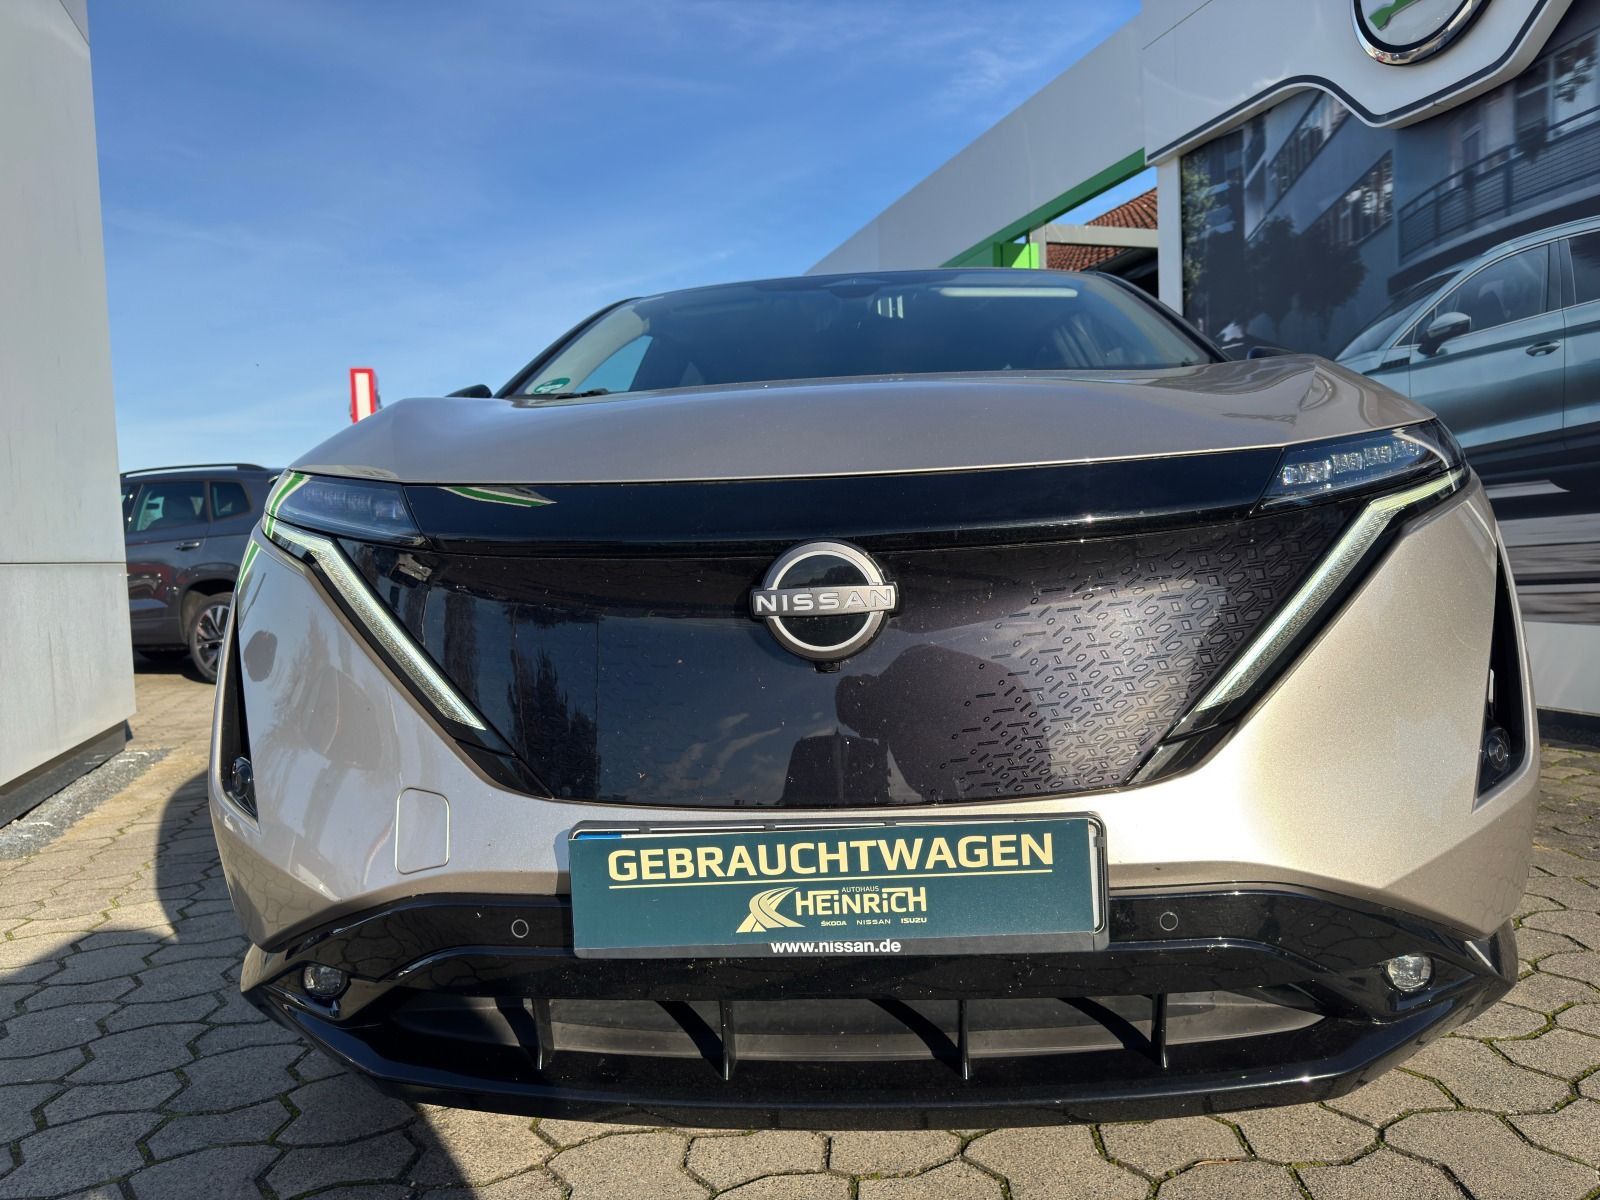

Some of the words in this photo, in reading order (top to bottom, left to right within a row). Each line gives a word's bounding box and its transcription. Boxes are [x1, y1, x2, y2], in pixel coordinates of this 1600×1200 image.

[756, 588, 892, 612] NISSAN
[607, 833, 1053, 881] GEBRAUCHTWAGEN
[841, 885, 880, 893] AUTOHAUS
[770, 938, 902, 954] www.nissan.de
